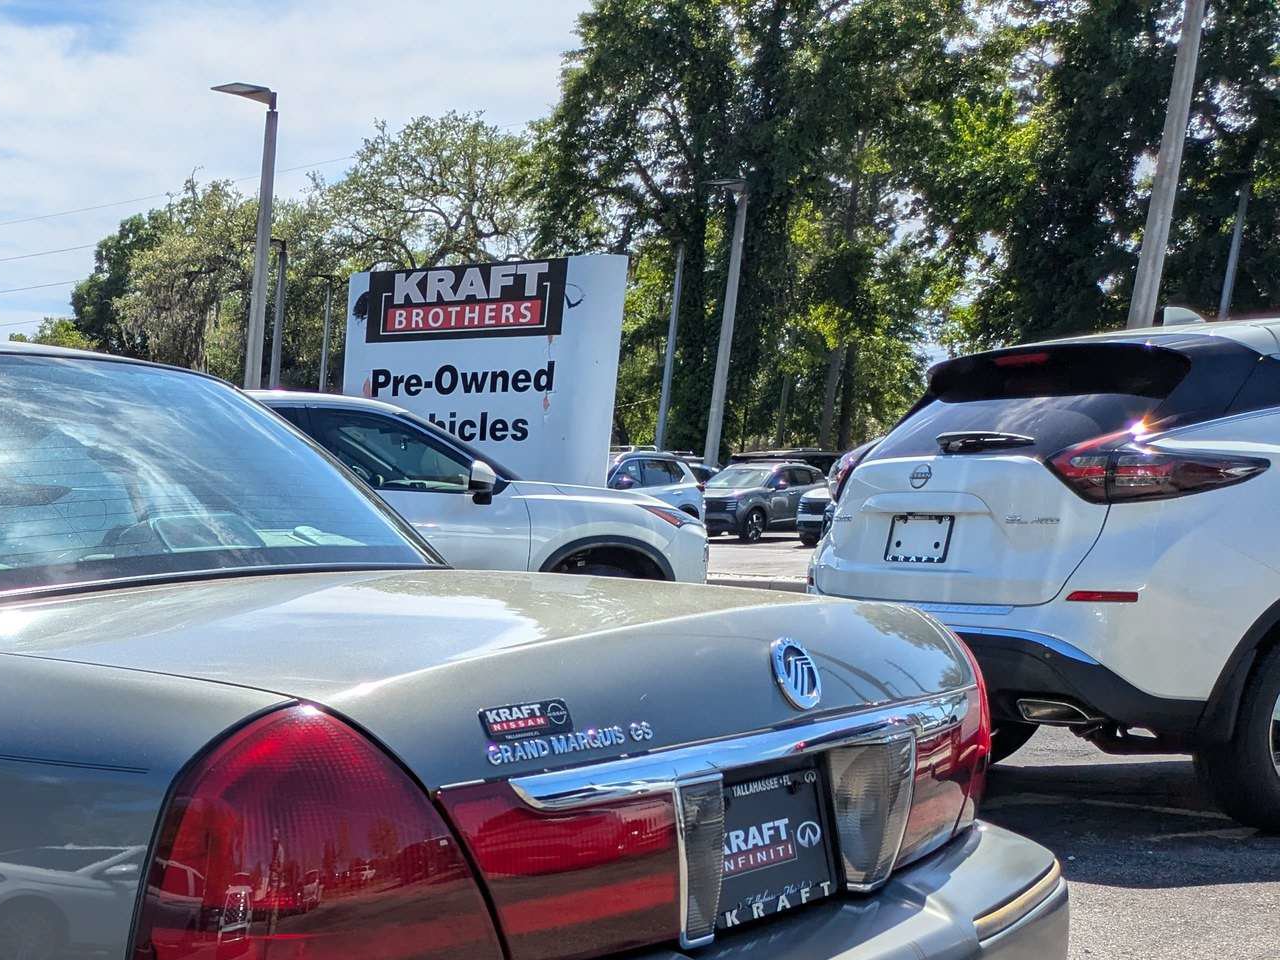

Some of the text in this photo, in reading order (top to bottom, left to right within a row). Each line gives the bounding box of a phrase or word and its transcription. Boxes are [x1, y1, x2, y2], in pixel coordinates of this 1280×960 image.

[393, 262, 549, 305] KRAFT
[394, 302, 532, 329] BROTHERS
[371, 360, 556, 398] Pre-Owned
[886, 554, 939, 563] KRAFT
[485, 703, 541, 723] KRAFT
[492, 717, 545, 731] NISSAN
[487, 720, 654, 766] GRAND MARQUIS GS
[732, 774, 792, 798] TALLAHASSEE FL
[723, 843, 793, 872] NFINITI
[724, 880, 831, 928] KRAFT
